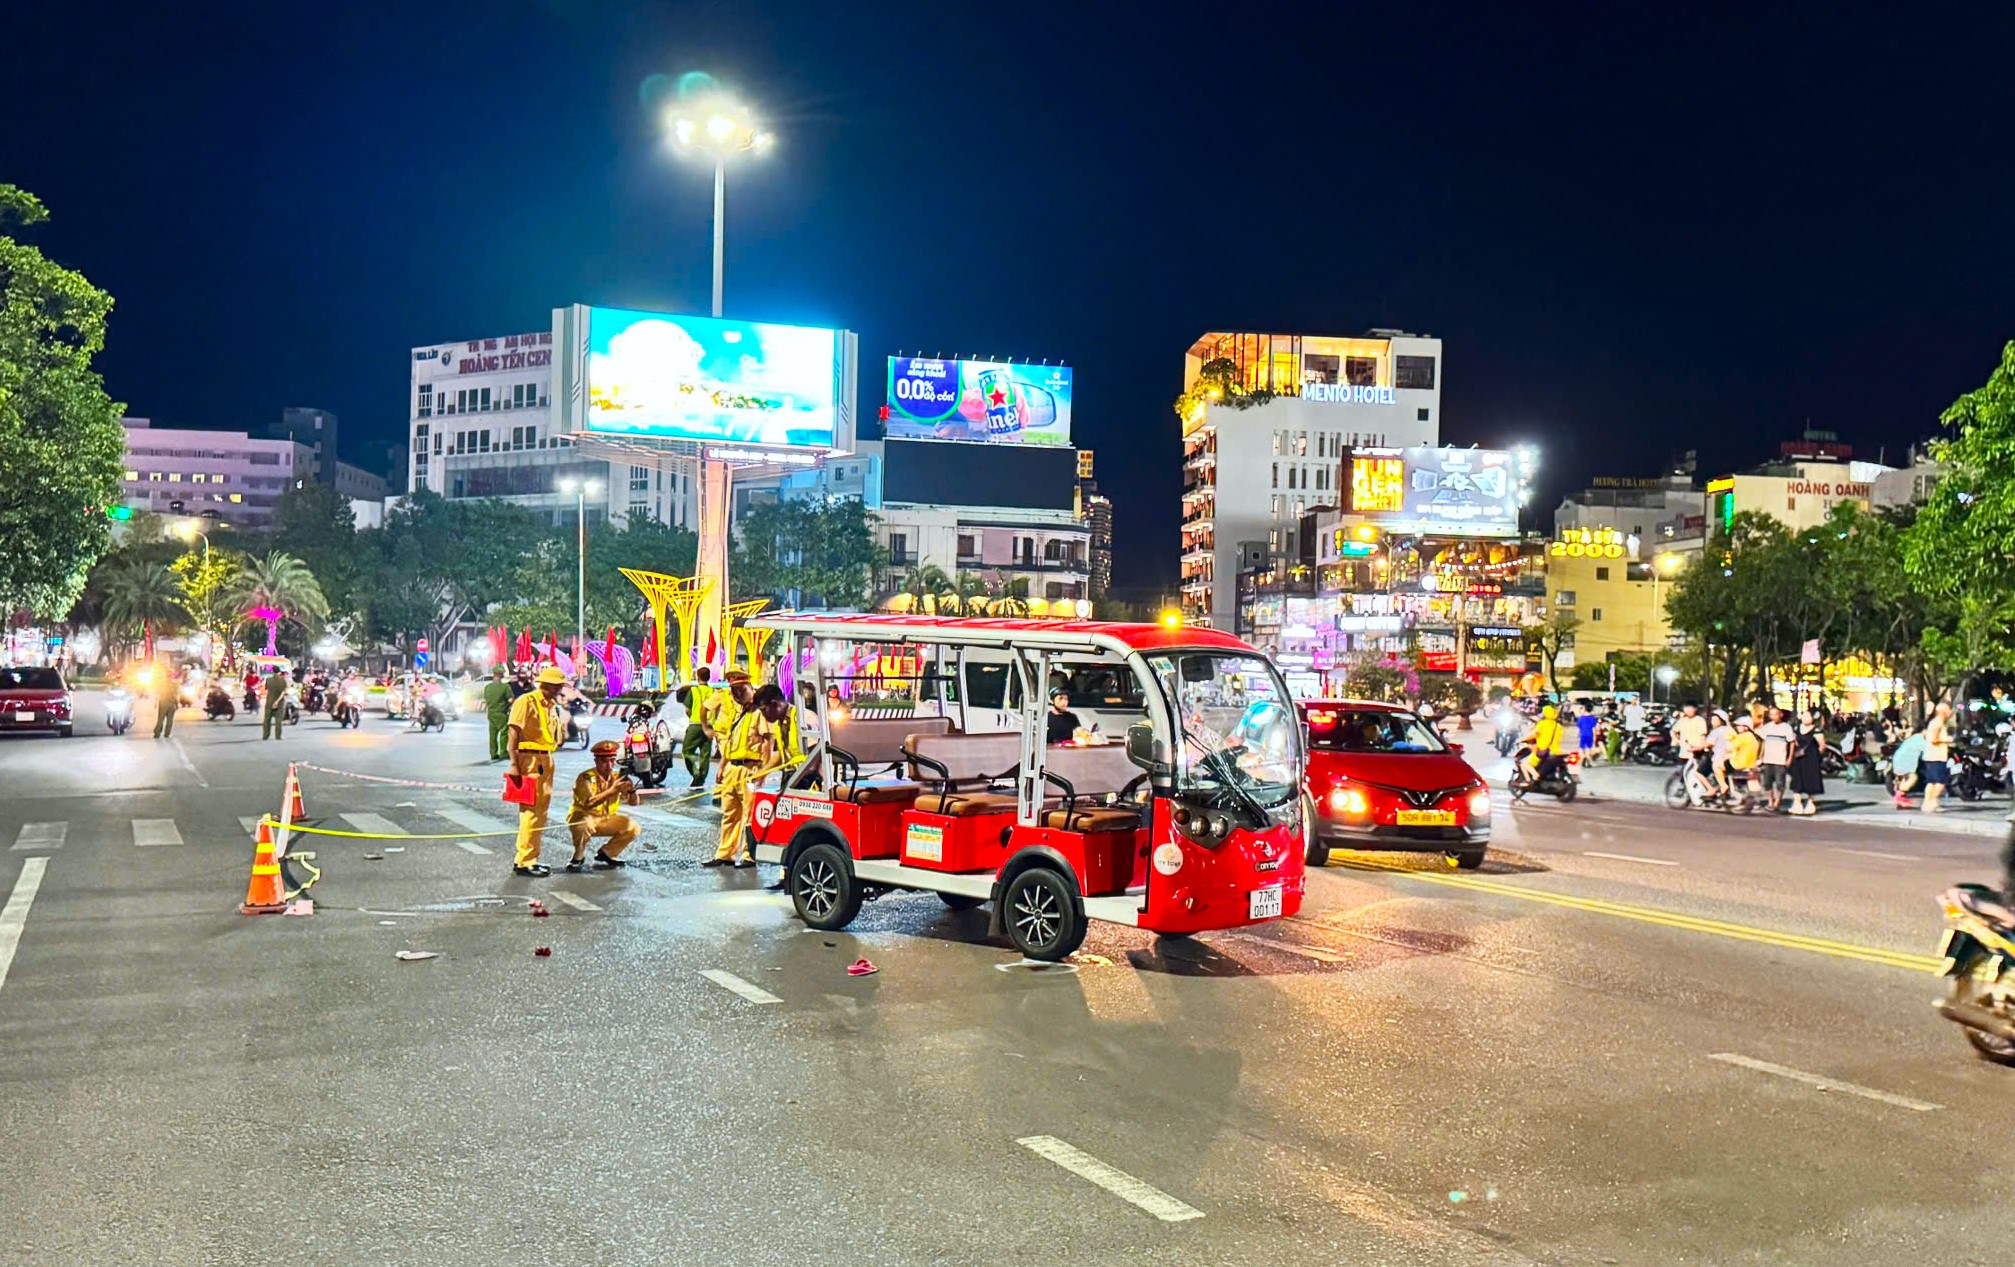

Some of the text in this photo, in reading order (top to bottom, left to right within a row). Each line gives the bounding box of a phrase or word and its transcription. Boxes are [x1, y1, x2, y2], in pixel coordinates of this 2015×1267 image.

[458, 354, 499, 374] HOÀNG
[501, 348, 525, 370] YẾN
[1303, 383, 1396, 405] MENTO HOTEL
[1787, 480, 1870, 497] HOÀNG OANH
[1562, 526, 1592, 544] TRÀ
[1551, 541, 1625, 558] 2000
[760, 807, 770, 820] 12
[1258, 890, 1277, 900] 77HC
